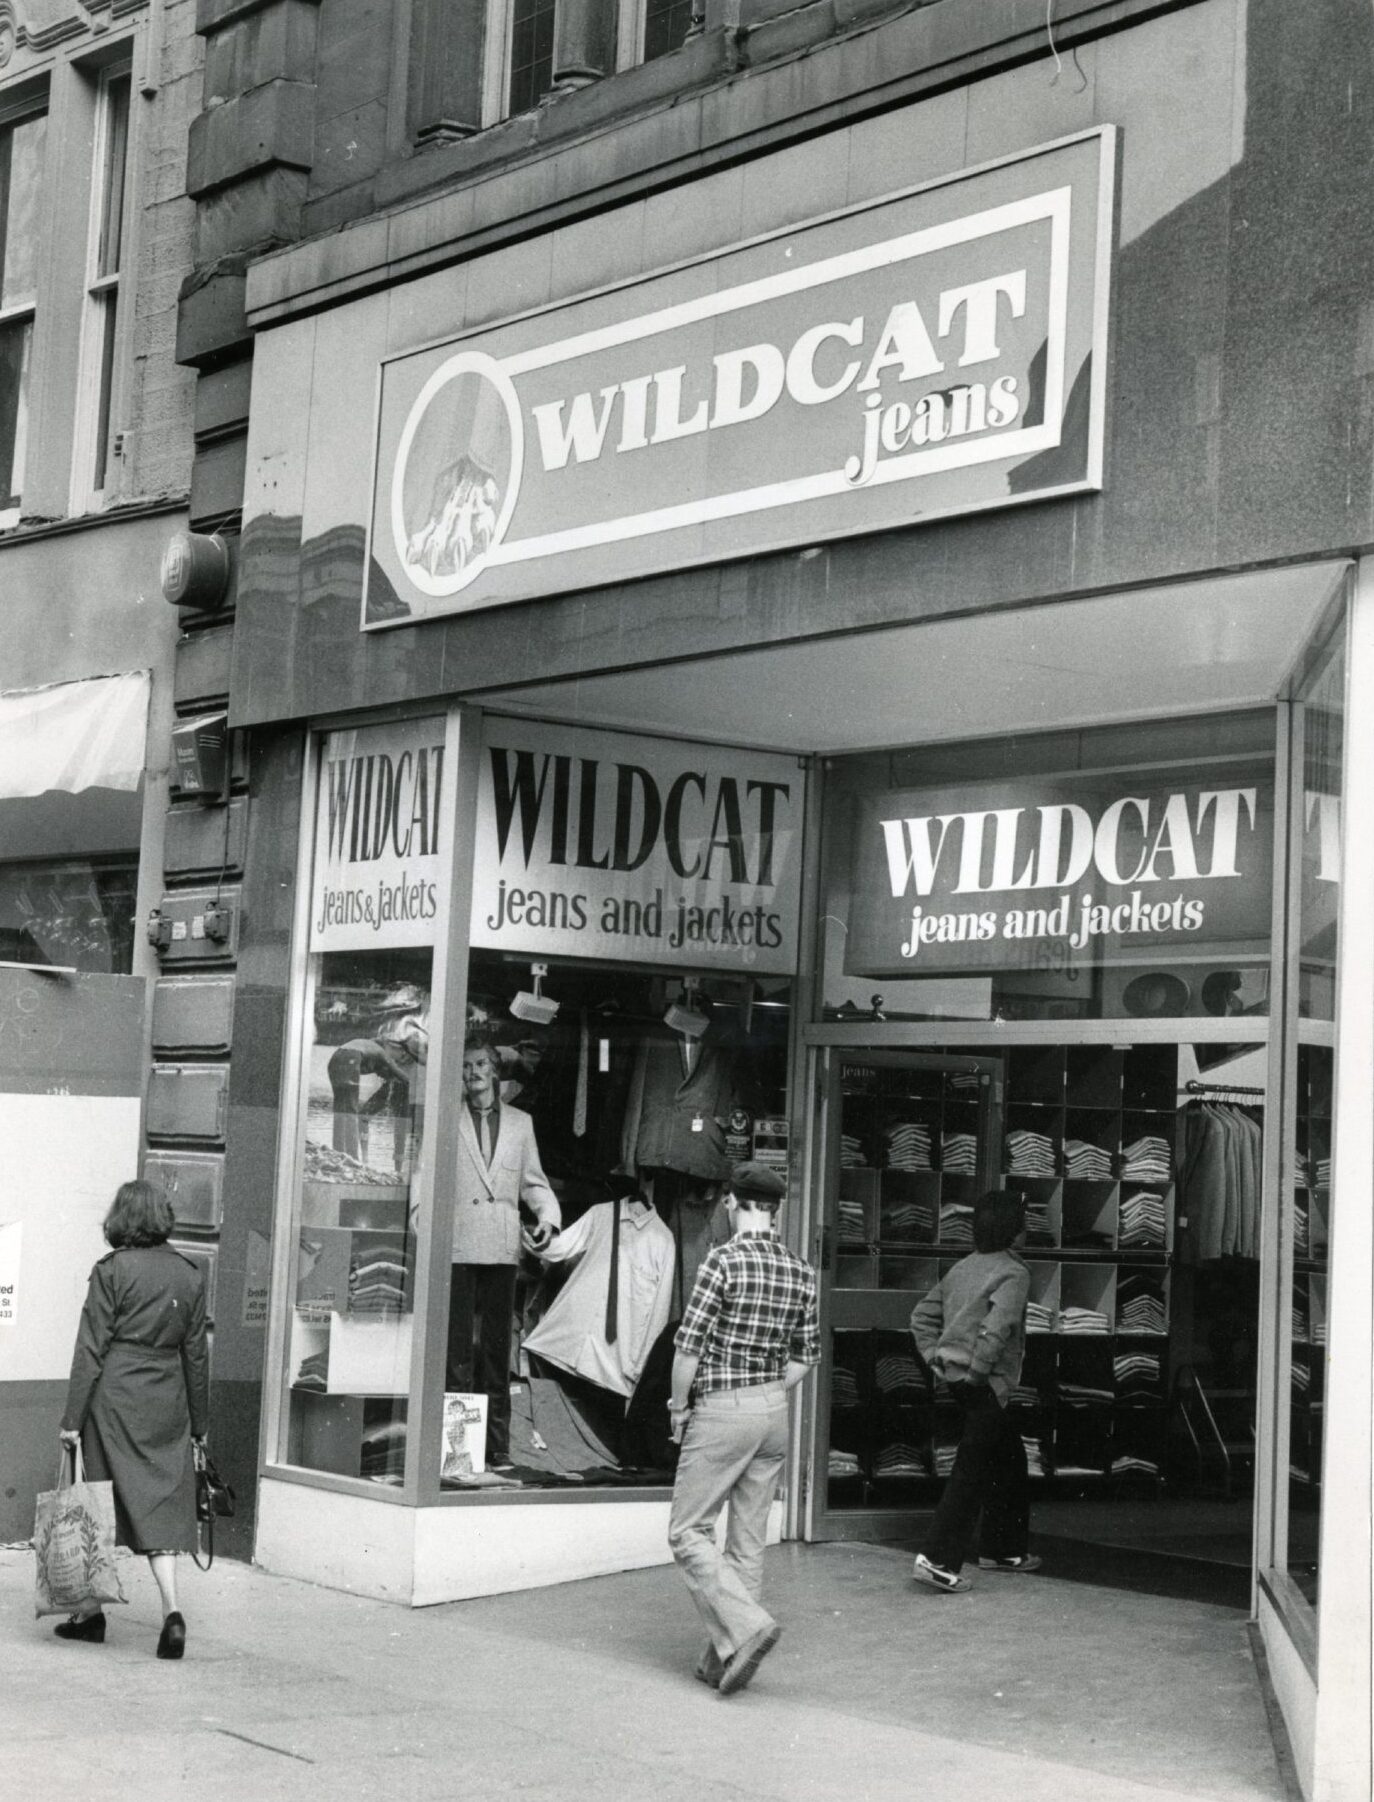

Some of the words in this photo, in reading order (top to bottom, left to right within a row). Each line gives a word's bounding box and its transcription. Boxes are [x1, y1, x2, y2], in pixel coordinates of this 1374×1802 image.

[532, 269, 1027, 471] WILDCAT
[844, 375, 1019, 487] jeans
[328, 745, 445, 865] WILDCAT
[488, 746, 790, 886] WILDCAT
[879, 787, 1257, 897] WILDCAT
[487, 879, 587, 931] jeans
[600, 887, 663, 938] and
[669, 895, 783, 949] jackets
[901, 905, 997, 958] jeans
[1002, 894, 1071, 938] and
[1069, 890, 1205, 950] jackets
